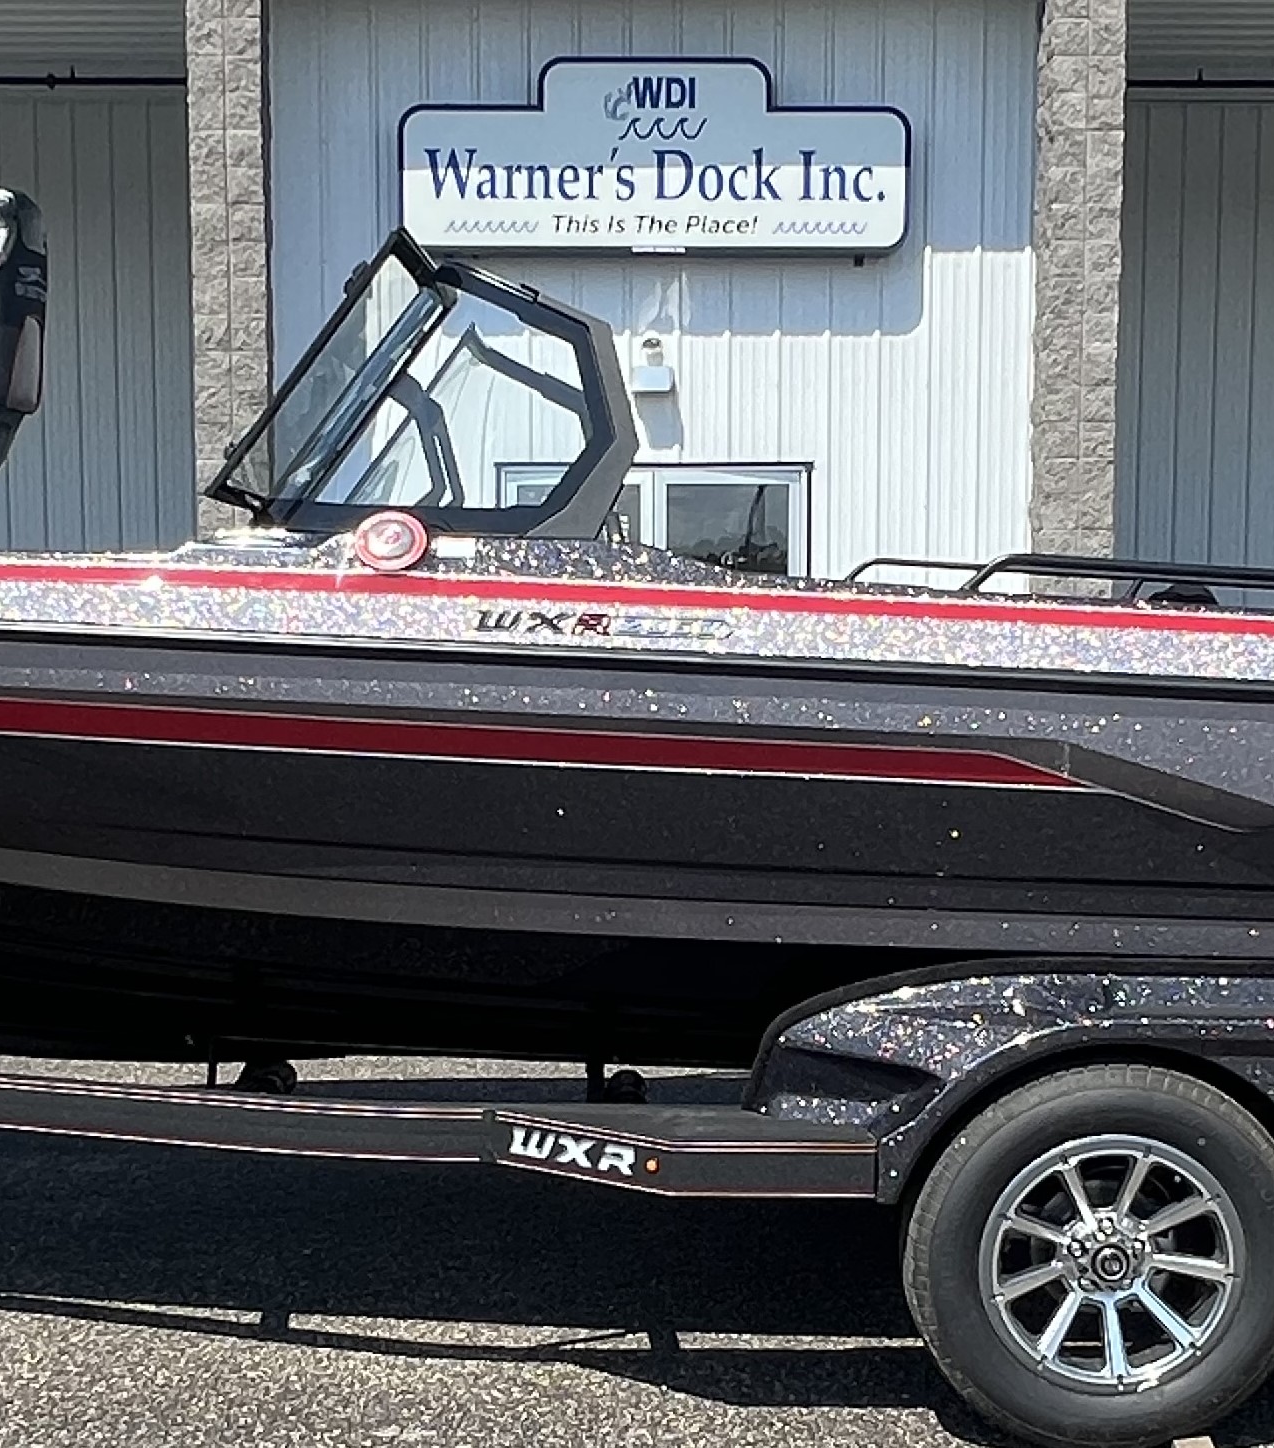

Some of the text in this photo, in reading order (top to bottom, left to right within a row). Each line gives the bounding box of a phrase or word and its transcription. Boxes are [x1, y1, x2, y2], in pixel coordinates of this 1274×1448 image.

[632, 76, 696, 109] WDI
[423, 147, 886, 202] Warner's Dock Inc.
[552, 214, 758, 235] This Is The Place!
[509, 1126, 636, 1176] WXR
